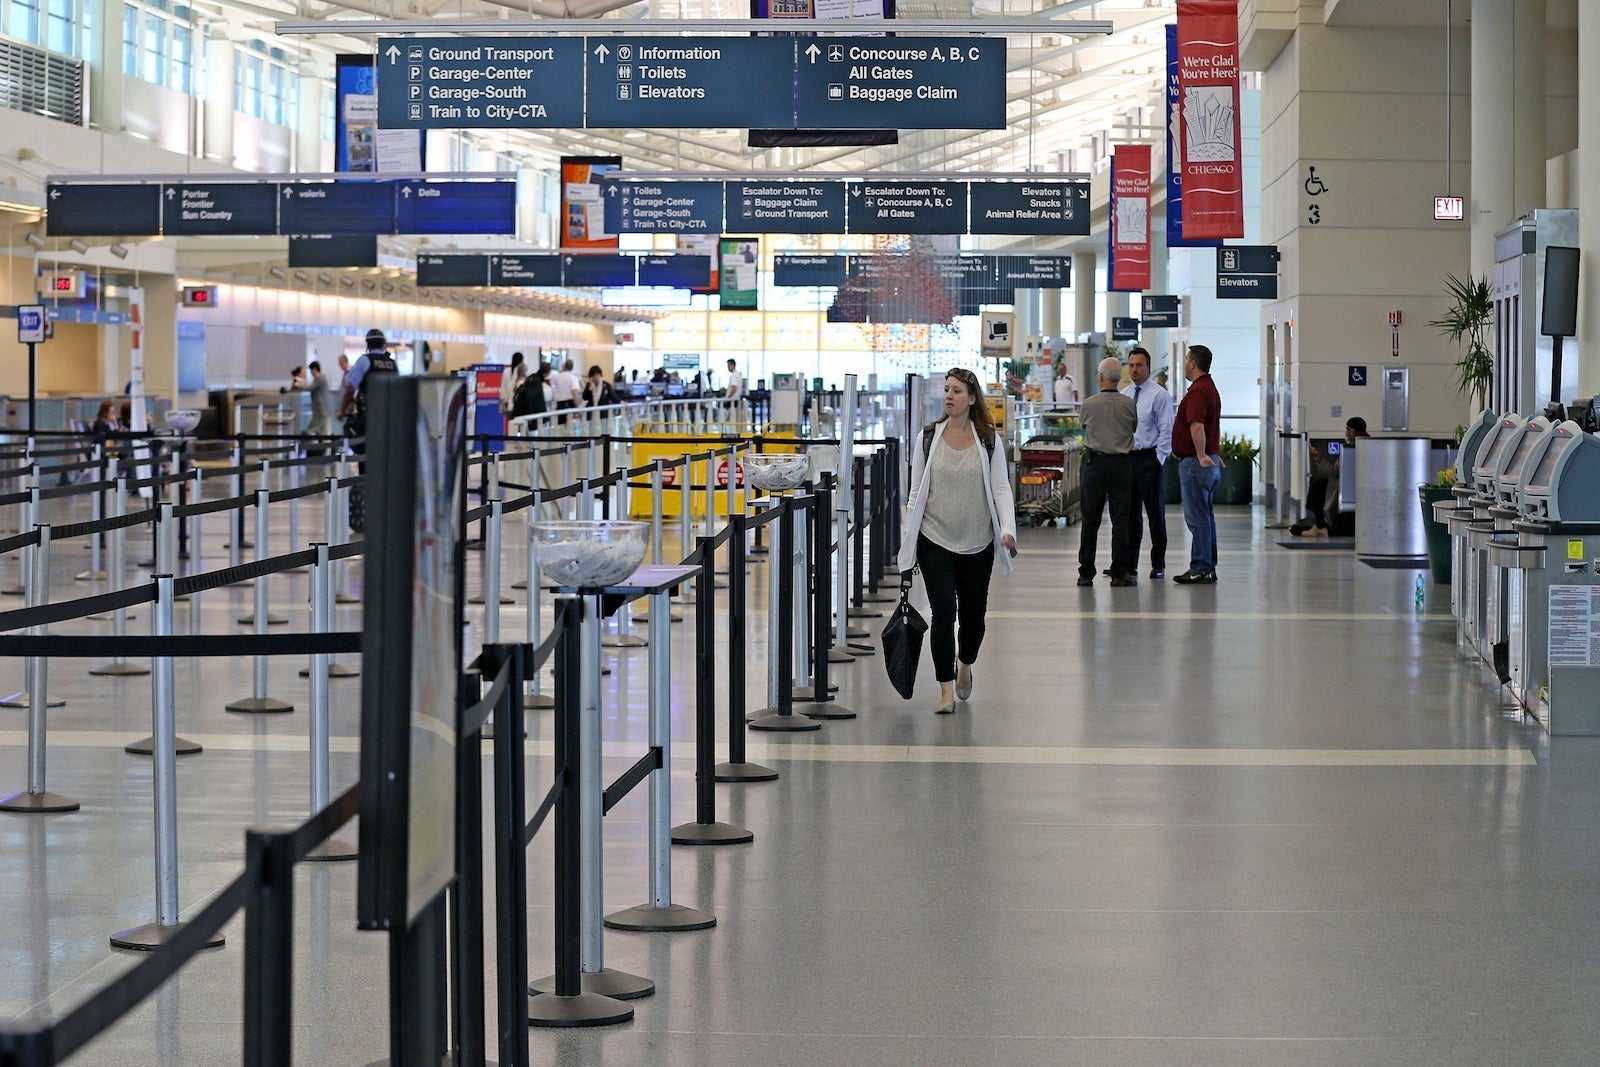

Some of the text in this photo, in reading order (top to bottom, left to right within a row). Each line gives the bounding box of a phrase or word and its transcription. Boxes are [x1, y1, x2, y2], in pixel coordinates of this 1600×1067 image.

[429, 47, 554, 63] Ground Transport
[639, 46, 721, 60] Information
[849, 46, 980, 62] Concourse A, B, C
[1183, 54, 1234, 67] We're Glad
[429, 67, 533, 82] Garage-Center
[639, 66, 686, 79] Toilets
[849, 66, 913, 79] All Gates
[1181, 67, 1237, 79] You're Here!
[429, 86, 526, 101] Garage-South
[639, 85, 705, 98] Elevators
[849, 85, 957, 101] Baggage Claim
[429, 105, 547, 120] Train to City-CTA
[1188, 165, 1234, 174] CHICAGO
[182, 190, 209, 198] Porter
[418, 188, 440, 197] Delta
[633, 187, 661, 195] Toilets
[743, 187, 823, 195] Escalator Down To:
[1022, 188, 1061, 196] Elevators
[182, 200, 214, 208] Frontier
[633, 198, 695, 207] Garage-Center
[755, 199, 818, 208] Baggage Claim
[877, 198, 953, 208] Concourse A, B, C
[1030, 199, 1061, 207] Snacks
[1437, 199, 1461, 214] EXIT
[182, 211, 232, 221] Sun Country
[633, 209, 691, 218] Garage-South
[755, 210, 828, 219] Ground Transport
[890, 209, 915, 218] Gates
[986, 210, 1061, 218] Animal Relief Area
[1308, 204, 1320, 224] 3
[669, 220, 707, 229] City-CTA
[1220, 278, 1258, 286] Elevators
[23, 316, 38, 327] EXIT
[374, 360, 394, 369] POLICE
